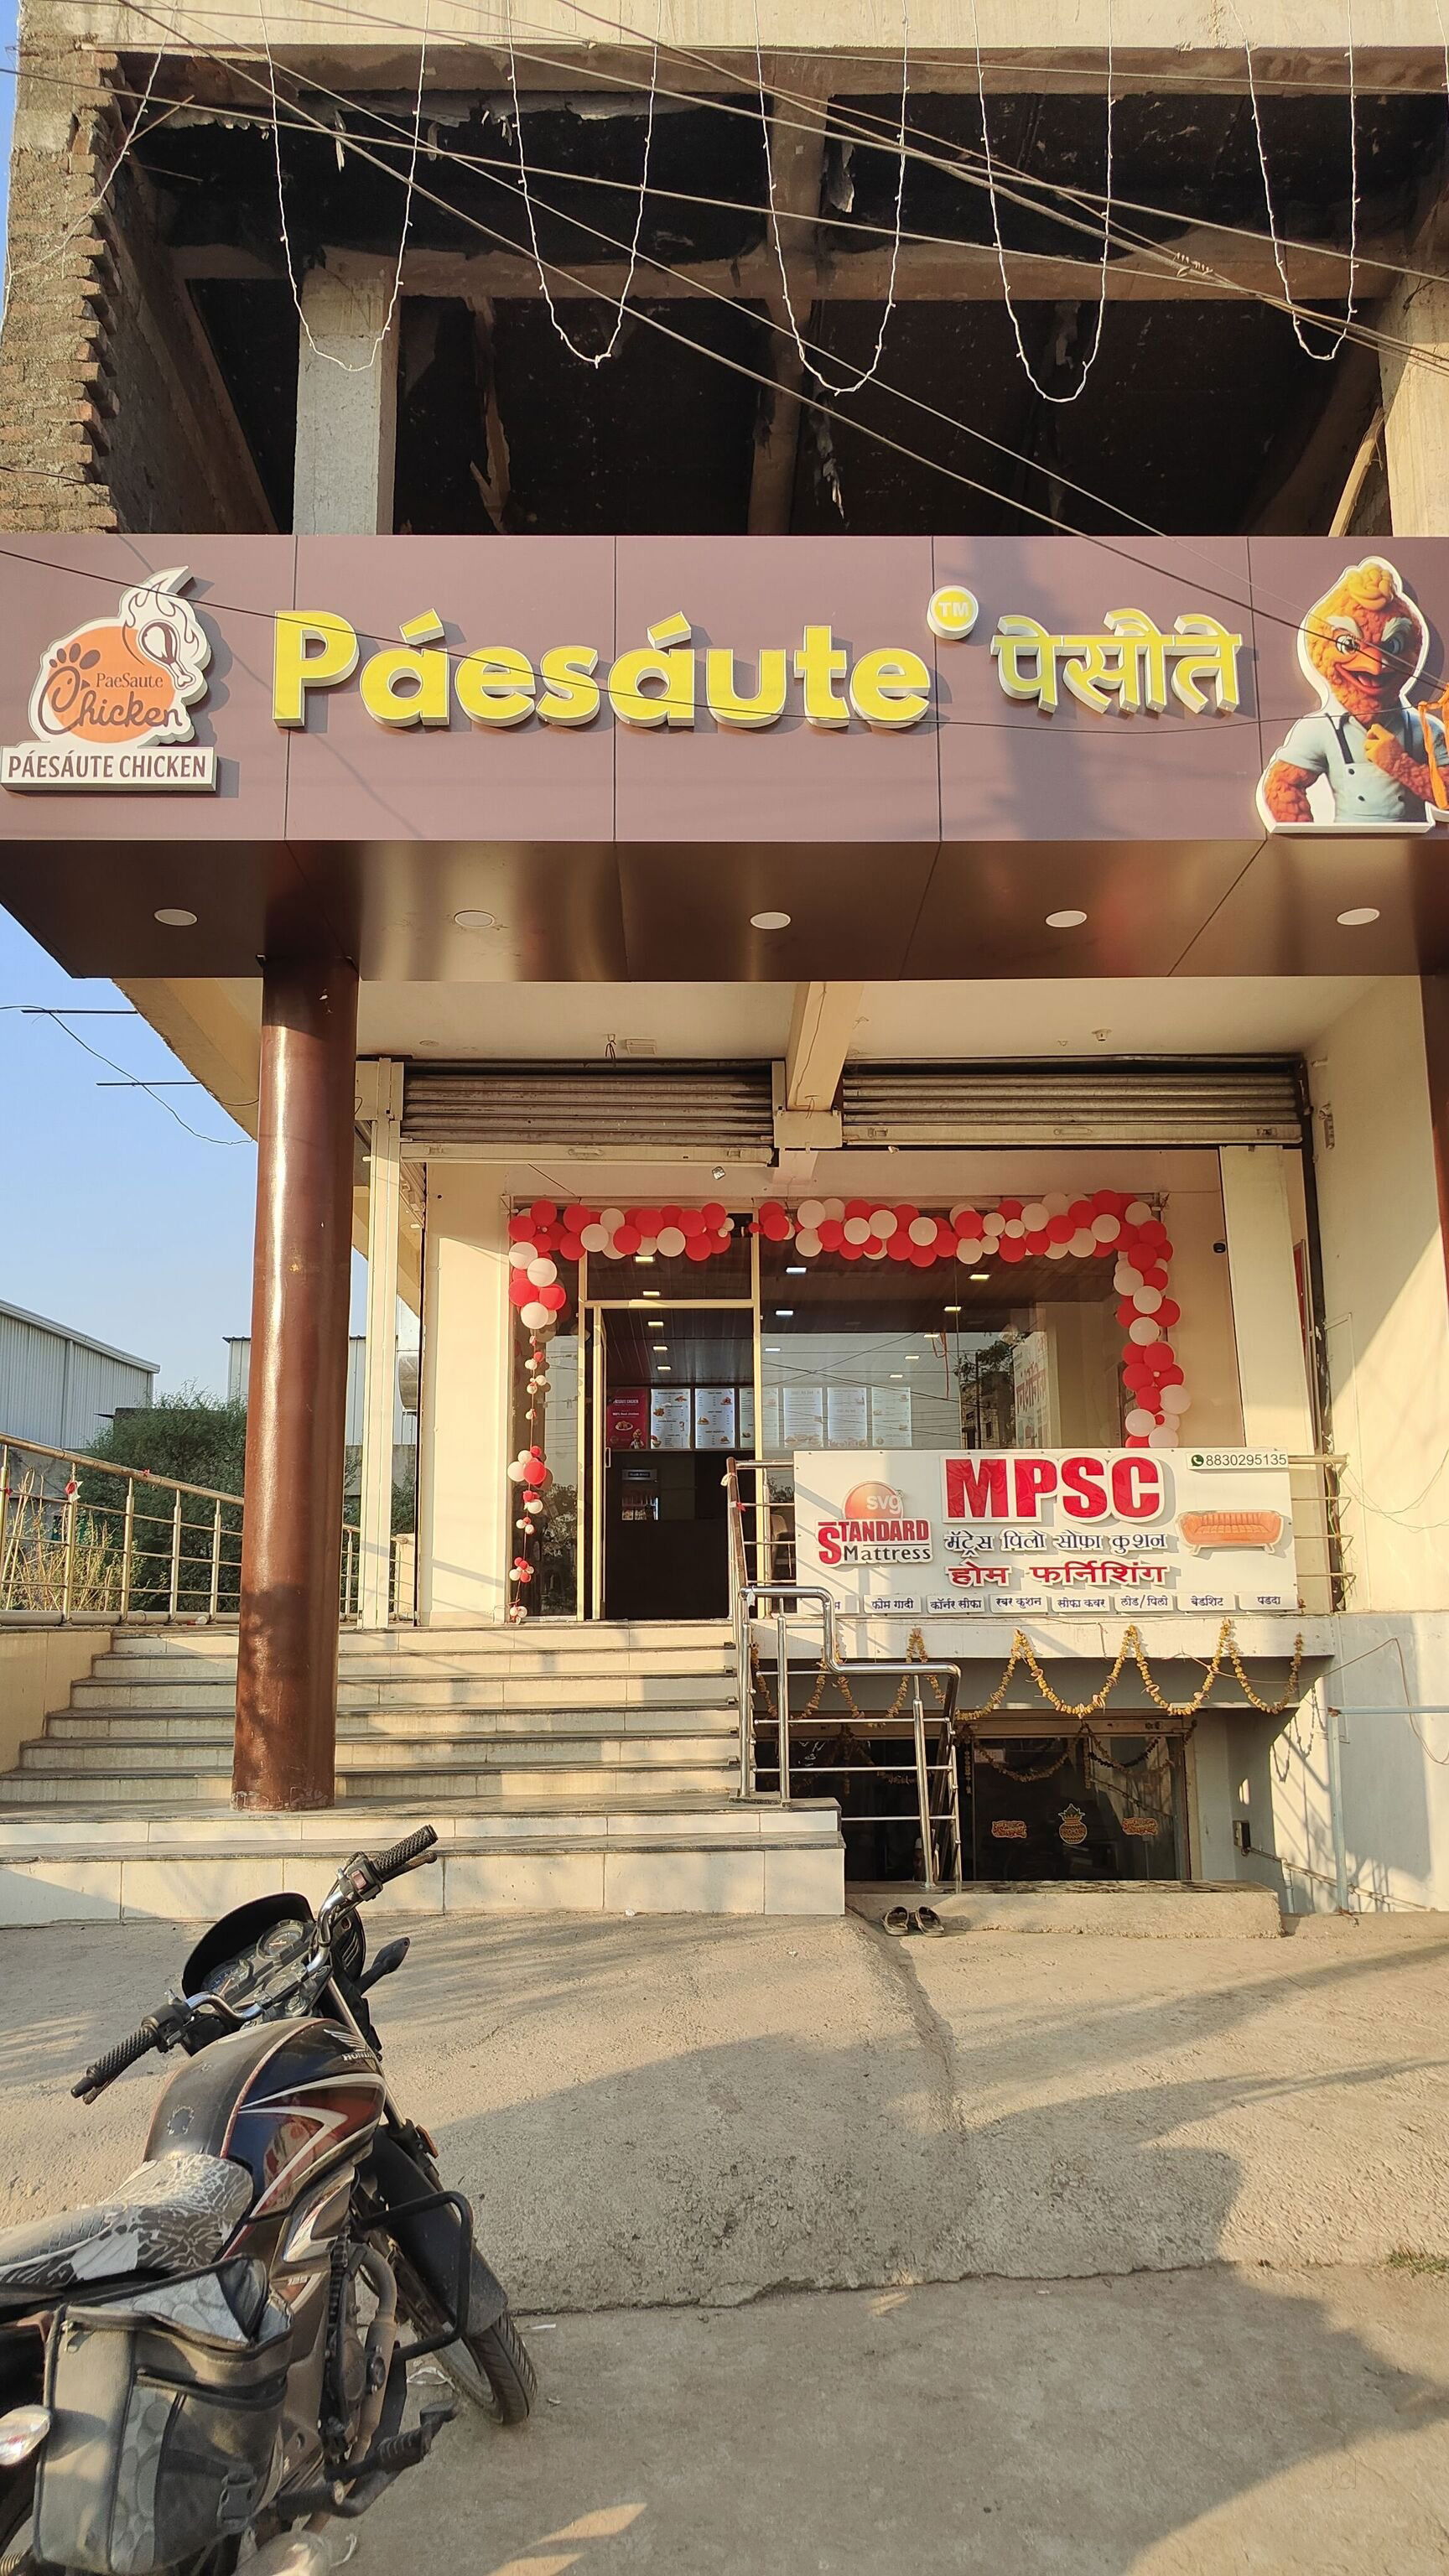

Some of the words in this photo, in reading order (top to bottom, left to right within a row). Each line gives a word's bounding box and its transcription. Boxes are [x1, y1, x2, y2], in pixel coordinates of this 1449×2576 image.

[937, 601, 969, 618] TM
[273, 608, 932, 729] Páesáute
[990, 608, 1243, 714] पेसौते
[96, 673, 164, 688] PaeSaute
[38, 665, 183, 735] Chicken
[8, 750, 114, 778] PÁESÁUTE
[118, 755, 206, 778] CHICKEN
[1205, 1453, 1287, 1467] 8830295135
[945, 1457, 1160, 1519] MPSC
[866, 1494, 902, 1515] svg
[818, 1519, 929, 1565] STANDARD
[1003, 1530, 1046, 1549] पिलो
[1055, 1530, 1101, 1549] सोफा
[1112, 1533, 1165, 1553] कुशन
[844, 1545, 931, 1561] Mattress
[948, 1561, 1010, 1583] होम
[1030, 1561, 1167, 1583] फर्निशिंग
[894, 1597, 914, 1609] गादी
[930, 1598, 956, 1610] कॉर्नर
[1015, 1597, 1042, 1609] कुशन
[1083, 1599, 1105, 1608] कवर
[1257, 1596, 1281, 1605] पडदा
[342, 2052, 375, 2061] HONDA
